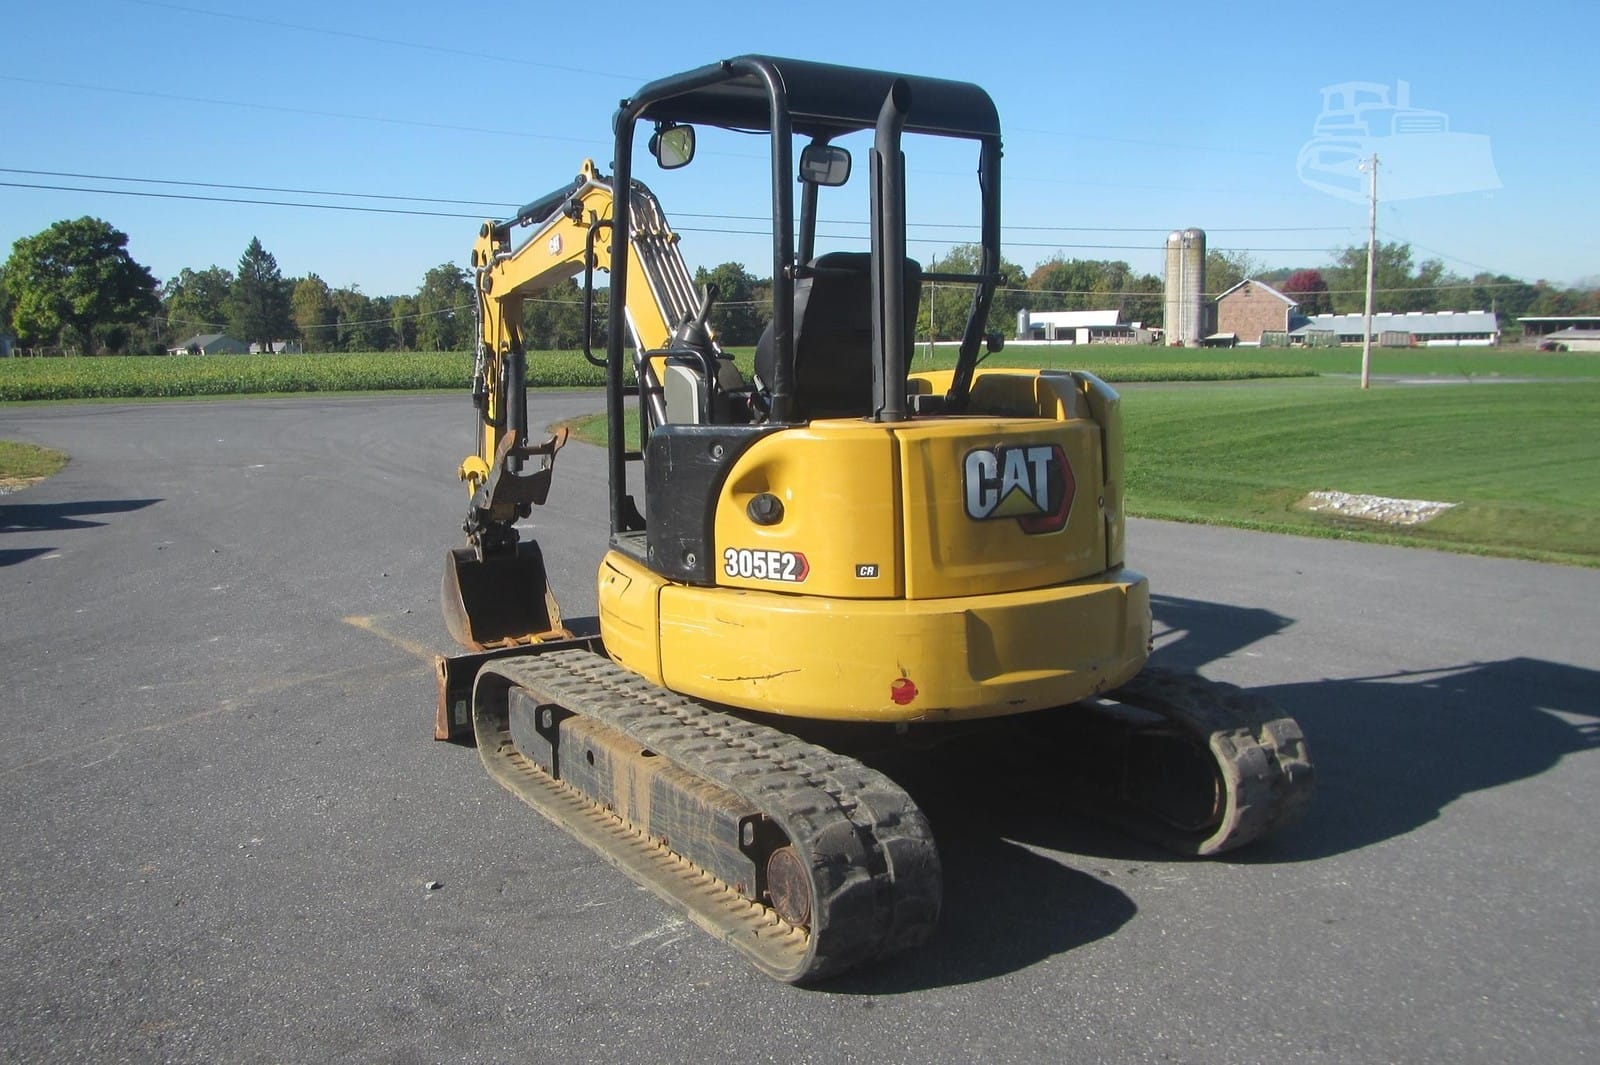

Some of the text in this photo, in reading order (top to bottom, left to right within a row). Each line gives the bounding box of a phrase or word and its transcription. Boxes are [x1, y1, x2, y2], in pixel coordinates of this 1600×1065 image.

[965, 447, 1053, 519] CAT
[725, 548, 797, 581] 305E2
[860, 566, 874, 576] CR
